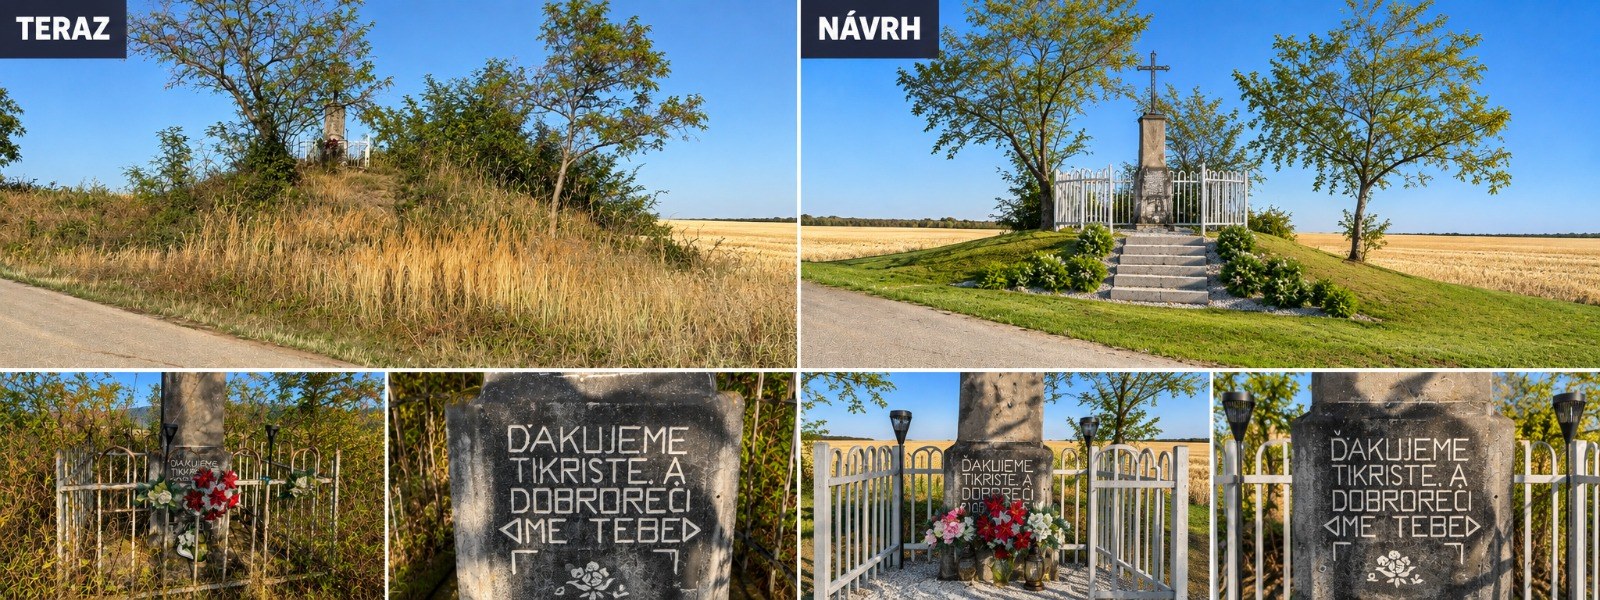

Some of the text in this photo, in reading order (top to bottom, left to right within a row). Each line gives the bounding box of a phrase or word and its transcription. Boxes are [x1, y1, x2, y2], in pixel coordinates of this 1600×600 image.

[507, 424, 690, 455] ĎAKUJEME
[1330, 430, 1470, 462] ĎAKUJEME
[663, 456, 687, 485] A
[1022, 473, 1033, 486] A
[1449, 463, 1468, 487] A
[510, 481, 691, 514] DOBROREČI
[1332, 483, 1472, 512] DOBROREČI
